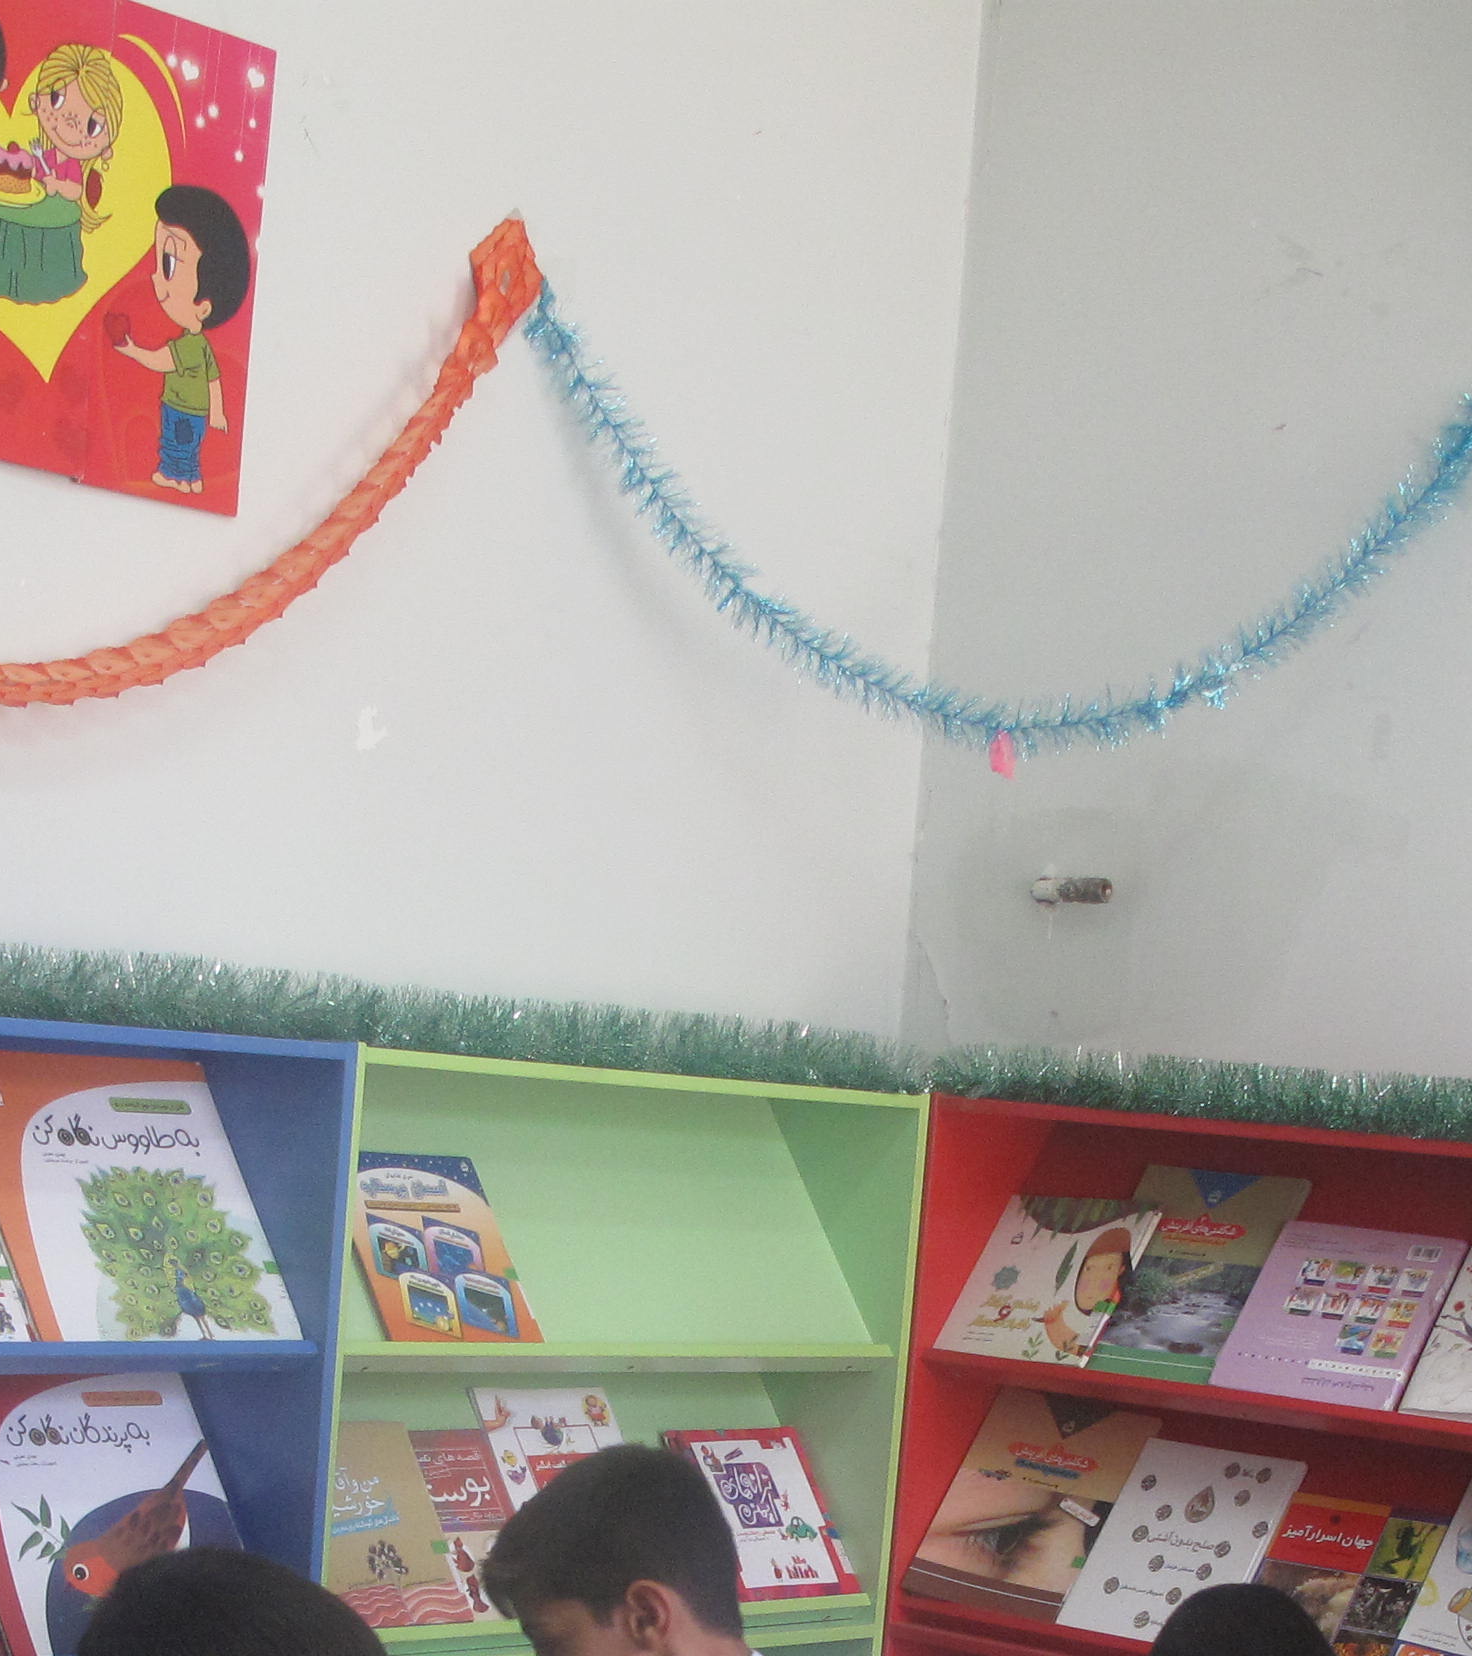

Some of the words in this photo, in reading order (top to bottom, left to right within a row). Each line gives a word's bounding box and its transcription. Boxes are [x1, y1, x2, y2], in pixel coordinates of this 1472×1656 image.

[32, 1114, 54, 1146] کن
[57, 1113, 100, 1147] نگاه
[101, 1125, 176, 1155] طاووس
[174, 1128, 201, 1157] به
[6, 1413, 28, 1446] کن
[29, 1413, 69, 1446] نگاه
[69, 1412, 131, 1453] پرندگان
[127, 1421, 152, 1447] به
[332, 1493, 385, 1518] خورشی
[1340, 1535, 1374, 1550] جهان
